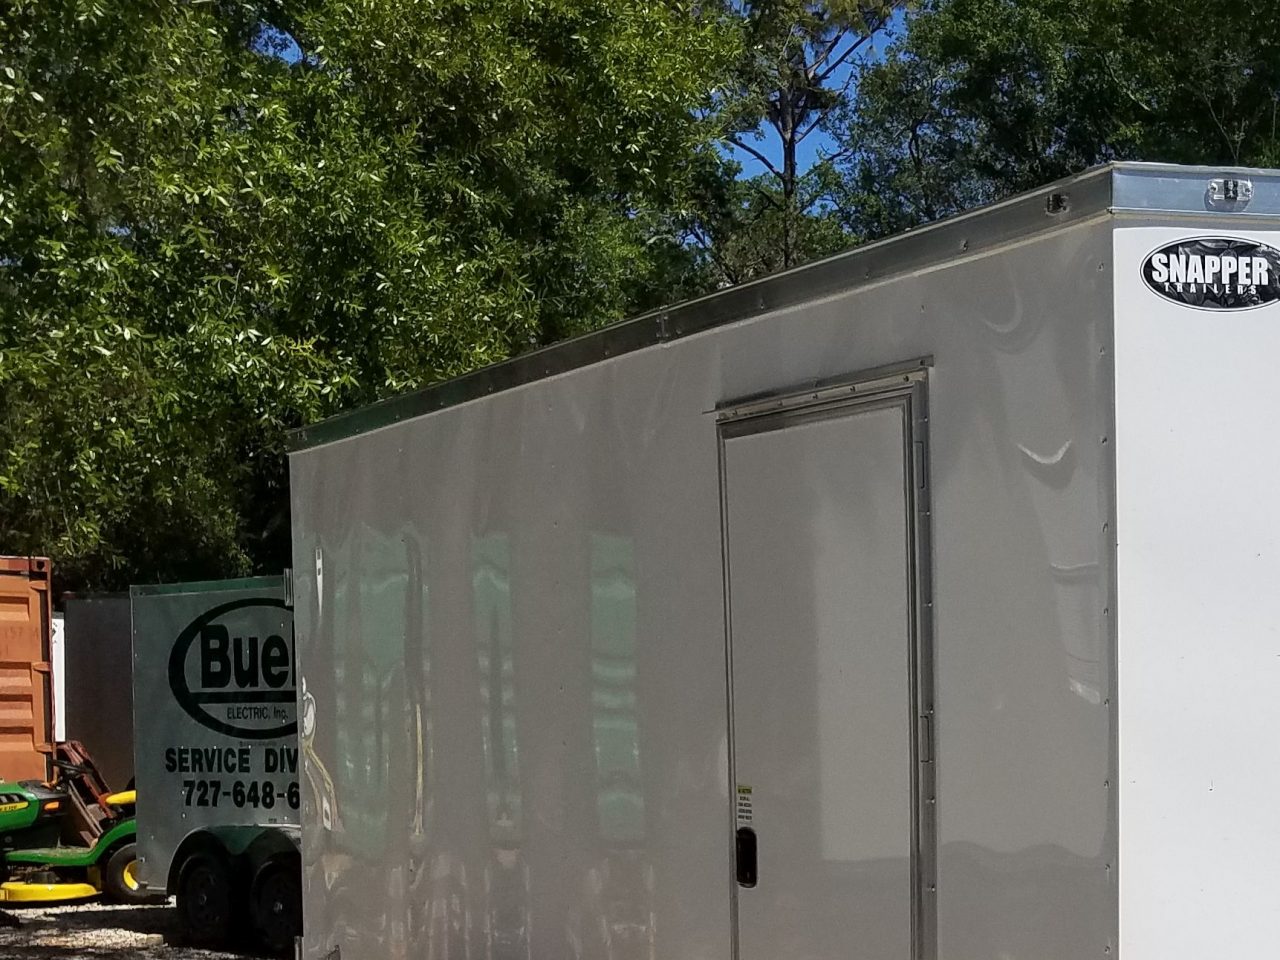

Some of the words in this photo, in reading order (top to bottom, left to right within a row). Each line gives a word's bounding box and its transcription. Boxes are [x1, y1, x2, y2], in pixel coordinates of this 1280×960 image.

[1152, 253, 1269, 286] SNAPPER
[1164, 281, 1257, 295] TRAILERS
[165, 747, 251, 773] SERVICE
[264, 748, 299, 773] DIV
[183, 780, 300, 810] 727-648-6
